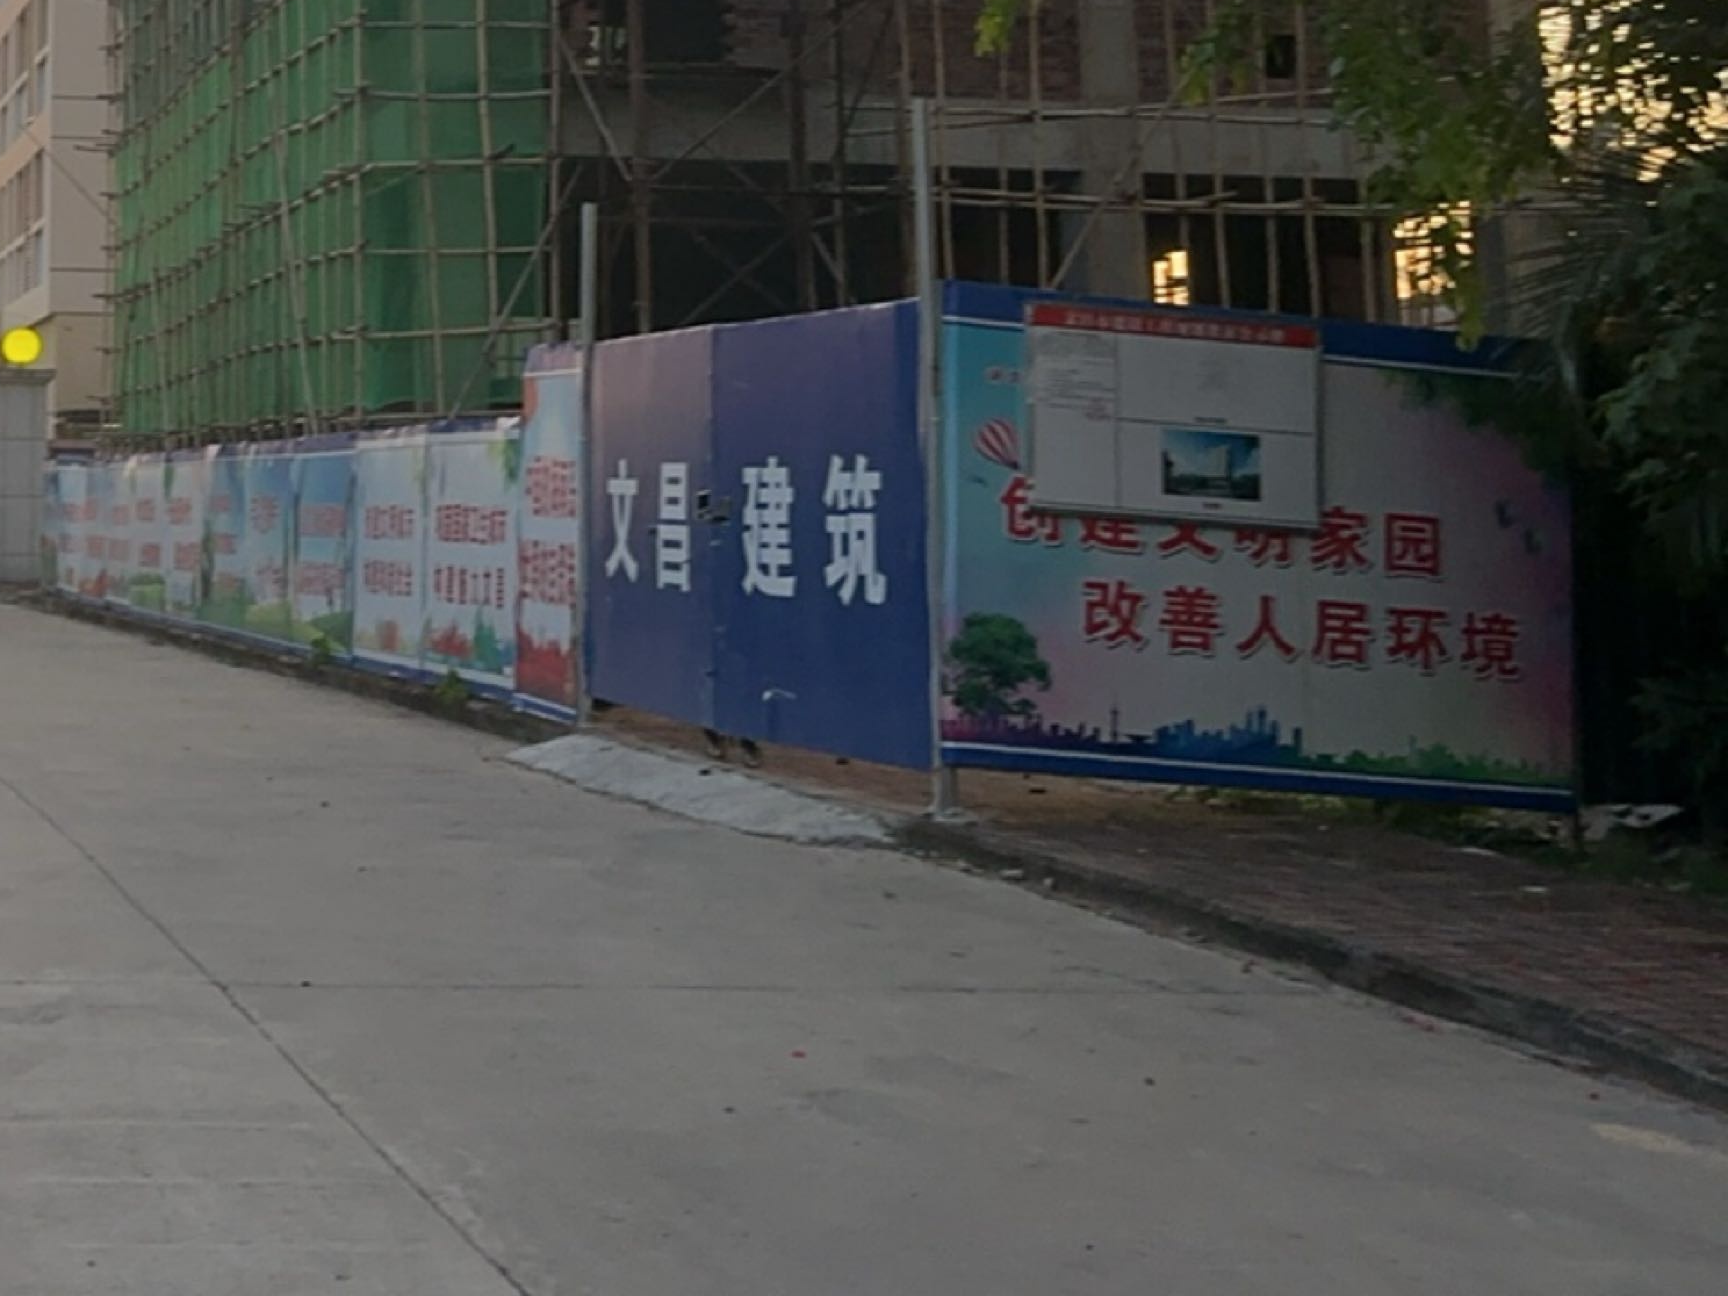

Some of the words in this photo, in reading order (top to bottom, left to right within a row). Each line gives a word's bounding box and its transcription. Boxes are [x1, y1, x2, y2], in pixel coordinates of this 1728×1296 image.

[605, 454, 887, 606] 文昌建筑
[1081, 578, 1524, 682] 改善人居环境
